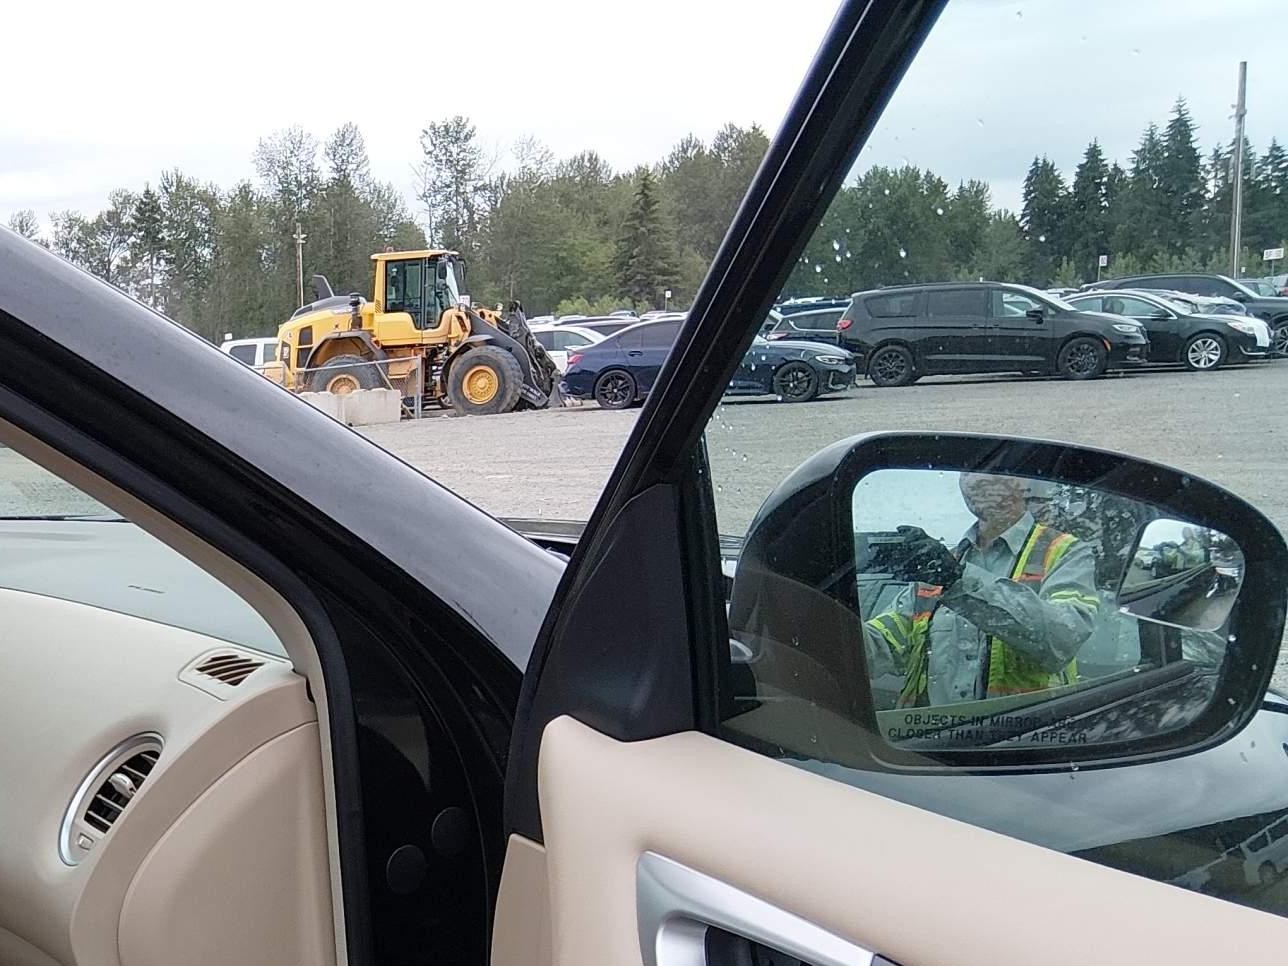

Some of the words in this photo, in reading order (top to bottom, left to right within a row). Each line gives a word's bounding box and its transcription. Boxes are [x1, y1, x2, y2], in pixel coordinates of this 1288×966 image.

[904, 713, 967, 726] OBJECTS
[971, 715, 984, 727] IN
[887, 727, 941, 739] CLOSER
[948, 729, 984, 740] THAN
[1030, 731, 1088, 744] APPEAR
